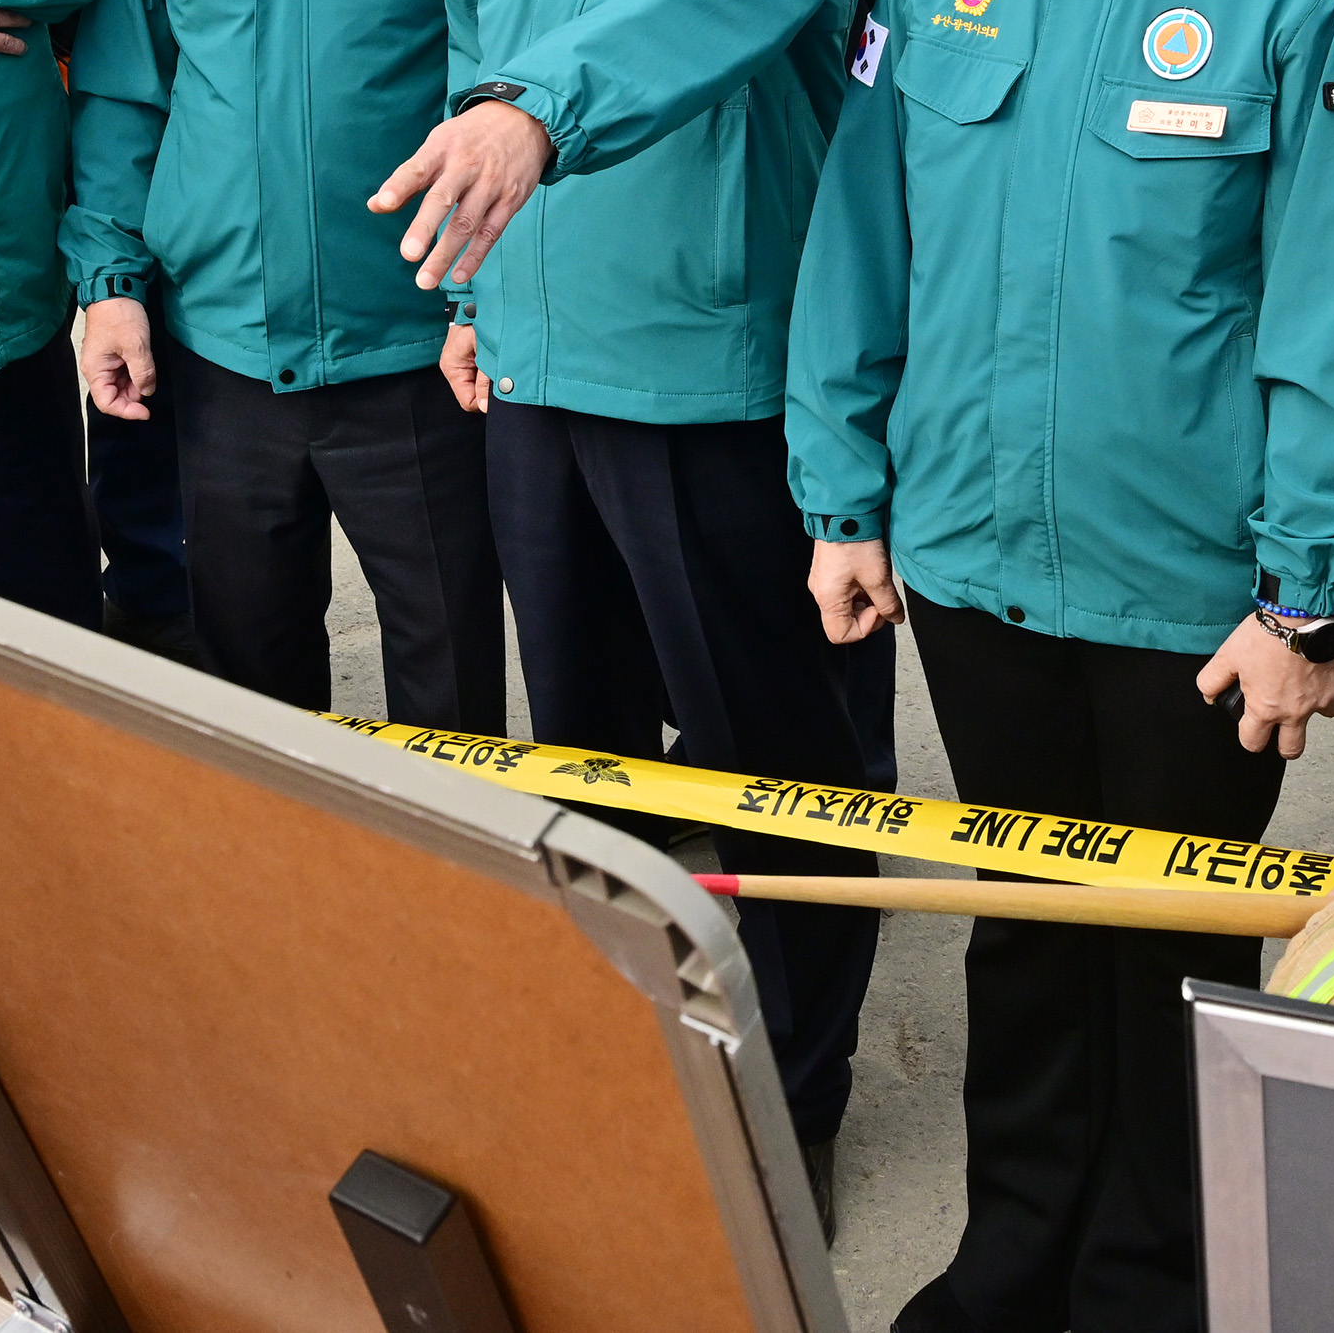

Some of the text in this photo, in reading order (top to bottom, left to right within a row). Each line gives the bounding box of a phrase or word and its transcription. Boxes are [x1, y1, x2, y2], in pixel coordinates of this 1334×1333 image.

[930, 13, 999, 40] 울산광역시의회
[403, 729, 541, 773] 출입금지
[736, 778, 923, 835] 화재조사중
[950, 807, 1135, 865] FIRE LINE
